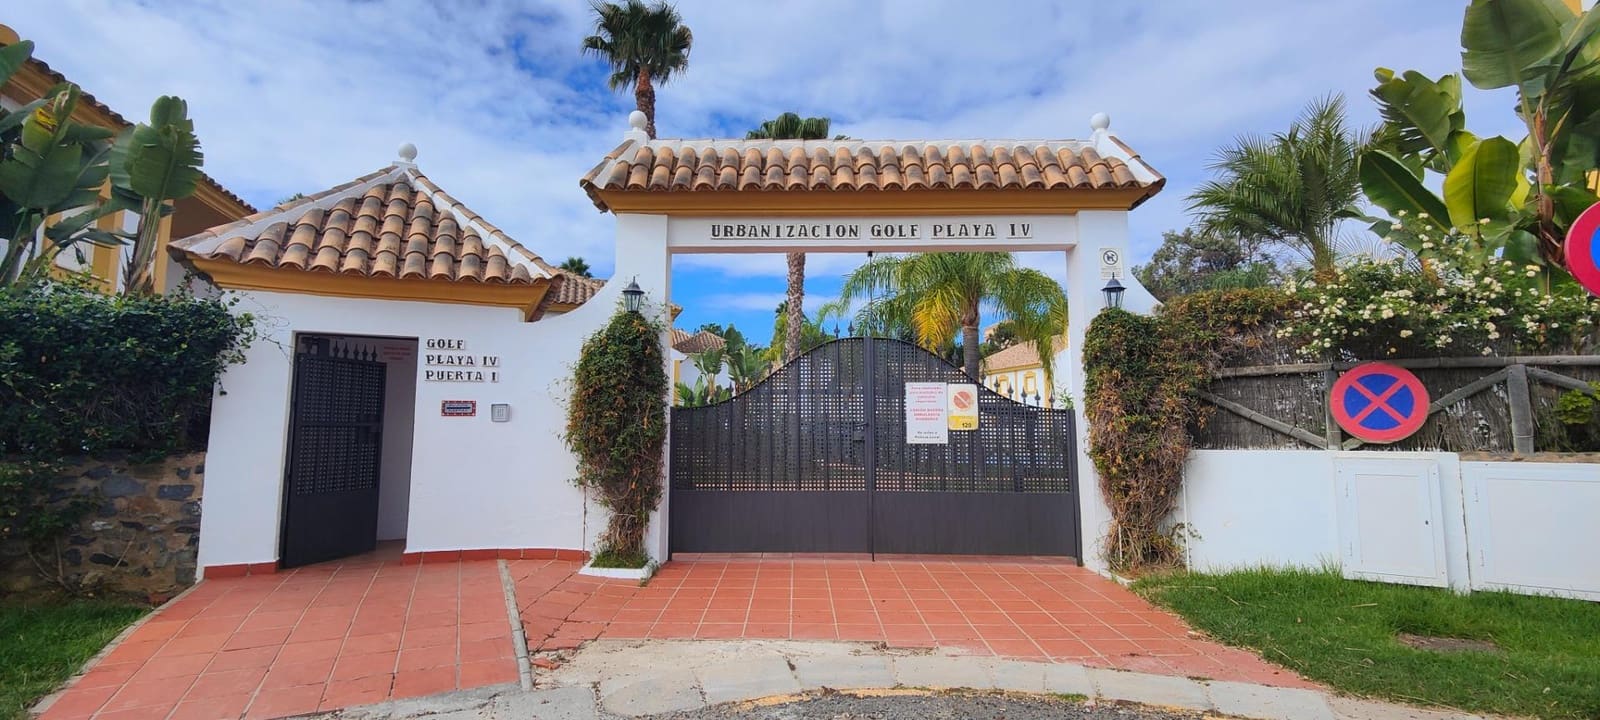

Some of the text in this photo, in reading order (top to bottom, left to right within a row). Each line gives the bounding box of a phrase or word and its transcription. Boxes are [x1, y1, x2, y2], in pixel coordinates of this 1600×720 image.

[711, 223, 1031, 238] URBANIZACION GOLF PLAYA IV
[426, 338, 464, 349] GOLF
[426, 354, 497, 366] PLAYA IV
[425, 370, 483, 381] PUERTA
